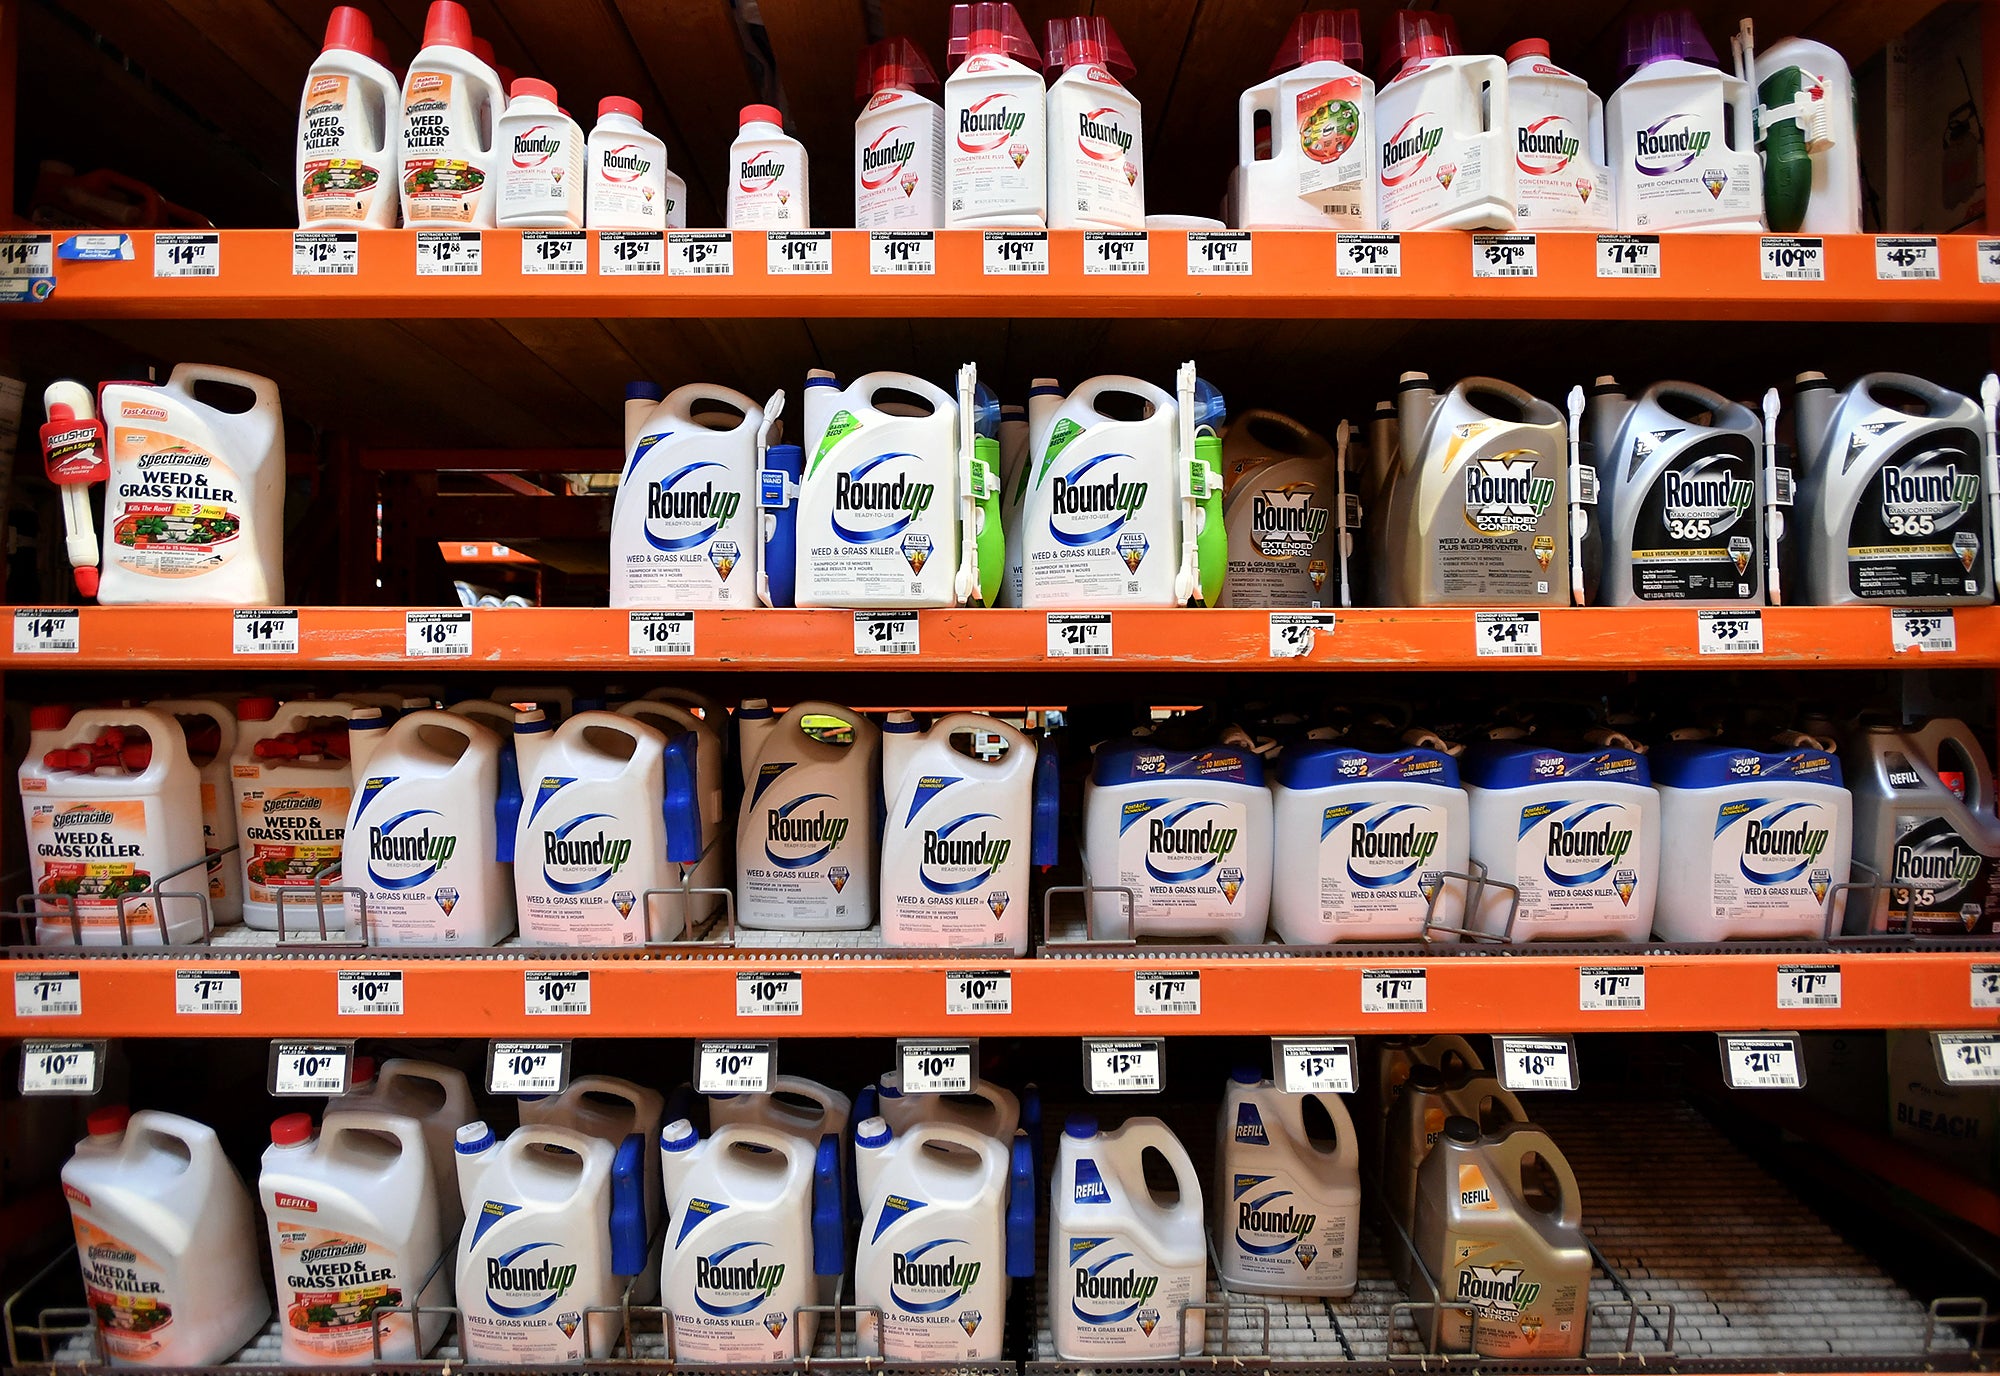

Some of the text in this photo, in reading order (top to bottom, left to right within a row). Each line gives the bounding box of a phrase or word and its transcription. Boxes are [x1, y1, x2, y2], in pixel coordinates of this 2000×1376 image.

[305, 102, 344, 119] Spectracide
[404, 101, 449, 115] Spectracide
[310, 117, 339, 129] WEED
[411, 116, 443, 127] WEED
[960, 108, 1025, 137] Roundup
[304, 127, 345, 140] & GRASS
[404, 126, 449, 138] & GRASS
[1079, 113, 1132, 153] Roundup
[306, 136, 340, 149] KILLER
[407, 136, 444, 148] KILLER
[514, 136, 560, 157] Roundup
[1382, 127, 1443, 168] Roundup
[1518, 128, 1580, 163] Roundup
[1637, 127, 1711, 157] Roundup
[603, 150, 651, 175] Roundup
[863, 138, 916, 172] Roundup
[953, 155, 991, 163] CONCENTRATE
[741, 159, 785, 181] Roundup
[1637, 177, 1699, 189] SUPER CONCENTRATE
[123, 408, 166, 417] Fast-Acting
[138, 453, 209, 468] Spectracide
[143, 471, 207, 486] WEED &
[1883, 465, 1979, 511] Roundup
[120, 484, 233, 502] GRASS KILLER
[836, 472, 934, 521] Roundup
[1054, 474, 1148, 520] Roundup
[1466, 466, 1555, 514] Roundup
[1666, 470, 1754, 517] Roundup
[648, 482, 741, 529] Roundup
[1253, 497, 1328, 543] Roundup
[1476, 515, 1537, 525] EXTENDED
[1478, 523, 1536, 532] CONTROL
[1670, 519, 1712, 539] 365
[1889, 516, 1934, 536] 365
[1261, 541, 1313, 550] EXTENDED
[1262, 548, 1310, 557] CONTROL
[679, 554, 702, 562] KILLER
[1141, 755, 1165, 764] PUMP
[1343, 758, 1367, 767] PUMP
[1539, 758, 1564, 767] PUMP
[1735, 757, 1760, 766] PUMP
[1890, 772, 1920, 785] REFILL
[264, 798, 321, 813] Spectracide
[53, 811, 113, 828] Spectracide
[265, 817, 321, 828] WEED &
[55, 832, 114, 845] WEED &
[247, 827, 345, 840] GRASS KILLER
[768, 809, 848, 850] Roundup
[38, 843, 141, 857] GRASS KILLER
[370, 827, 456, 869] Roundup
[1150, 820, 1237, 864] Roundup
[1351, 823, 1438, 867] Roundup
[1548, 822, 1632, 864] Roundup
[1746, 821, 1828, 864] Roundup
[545, 831, 631, 874] Roundup
[924, 831, 1011, 873] Roundup
[1897, 847, 1981, 887] Roundup
[1150, 886, 1166, 894] WEED
[1168, 886, 1174, 894] &
[1175, 886, 1195, 894] GRASS
[1897, 1101, 1979, 1139] BLEACH
[1236, 1124, 1263, 1137] REFILL
[1076, 1181, 1104, 1199] REFILL
[1461, 1189, 1490, 1204] REFILL
[280, 1197, 311, 1209] REFILL
[1239, 1202, 1316, 1242] Roundup
[88, 1244, 136, 1263] Spectracide
[300, 1241, 366, 1263] Spectracide
[91, 1261, 137, 1280] WEED &
[287, 1268, 392, 1288] GRASS KILLER
[306, 1261, 367, 1276] WEED &
[697, 1256, 786, 1299] Roundup
[893, 1253, 981, 1295] Roundup
[84, 1271, 162, 1294] GRASS KILLER
[488, 1257, 576, 1300] Roundup
[1076, 1267, 1158, 1308] Roundup
[1457, 1269, 1540, 1312] Roundup
